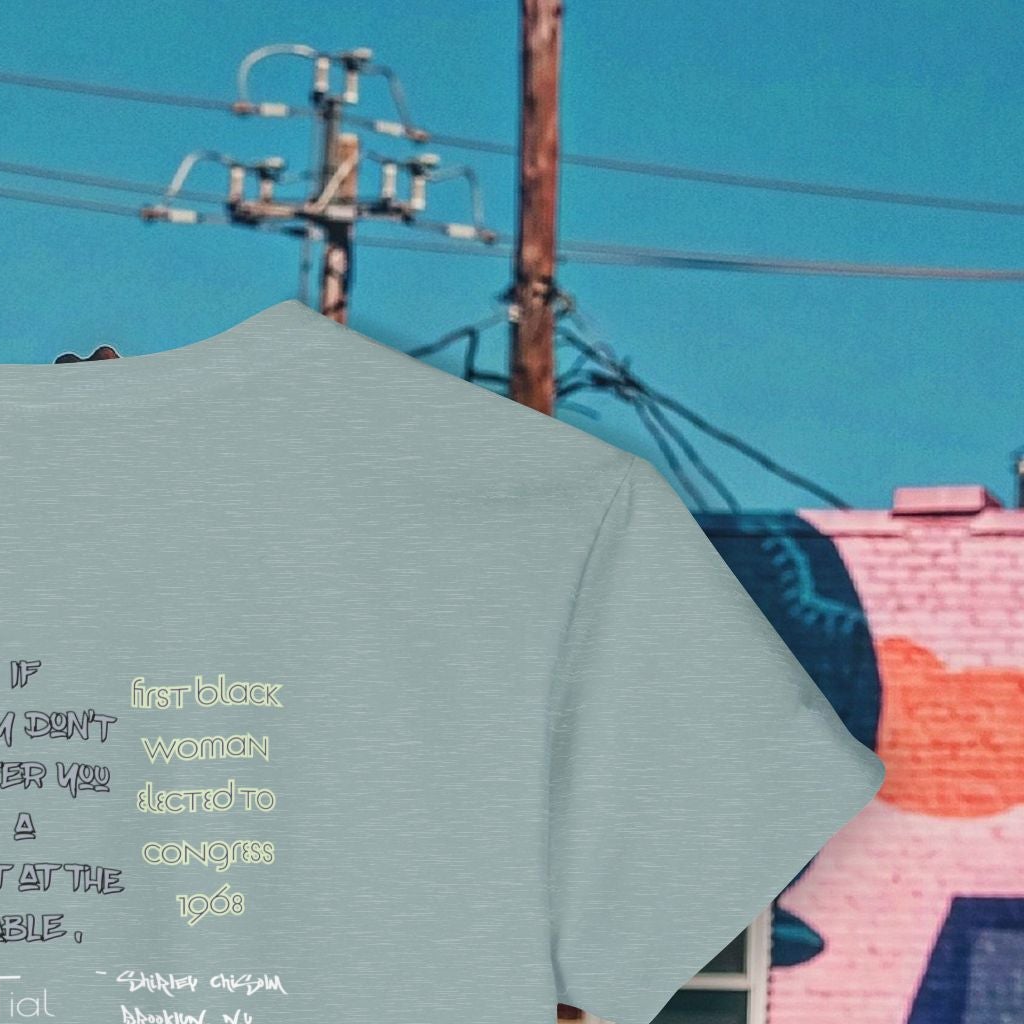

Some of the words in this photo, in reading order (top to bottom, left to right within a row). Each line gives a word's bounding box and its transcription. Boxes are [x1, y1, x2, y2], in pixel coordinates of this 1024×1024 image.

[10, 660, 42, 689] IF
[24, 709, 118, 743] DON'T
[56, 761, 111, 799] YOU
[13, 812, 36, 841] A
[18, 863, 62, 892] AT
[63, 863, 125, 895] THE
[176, 883, 245, 927] 1968
